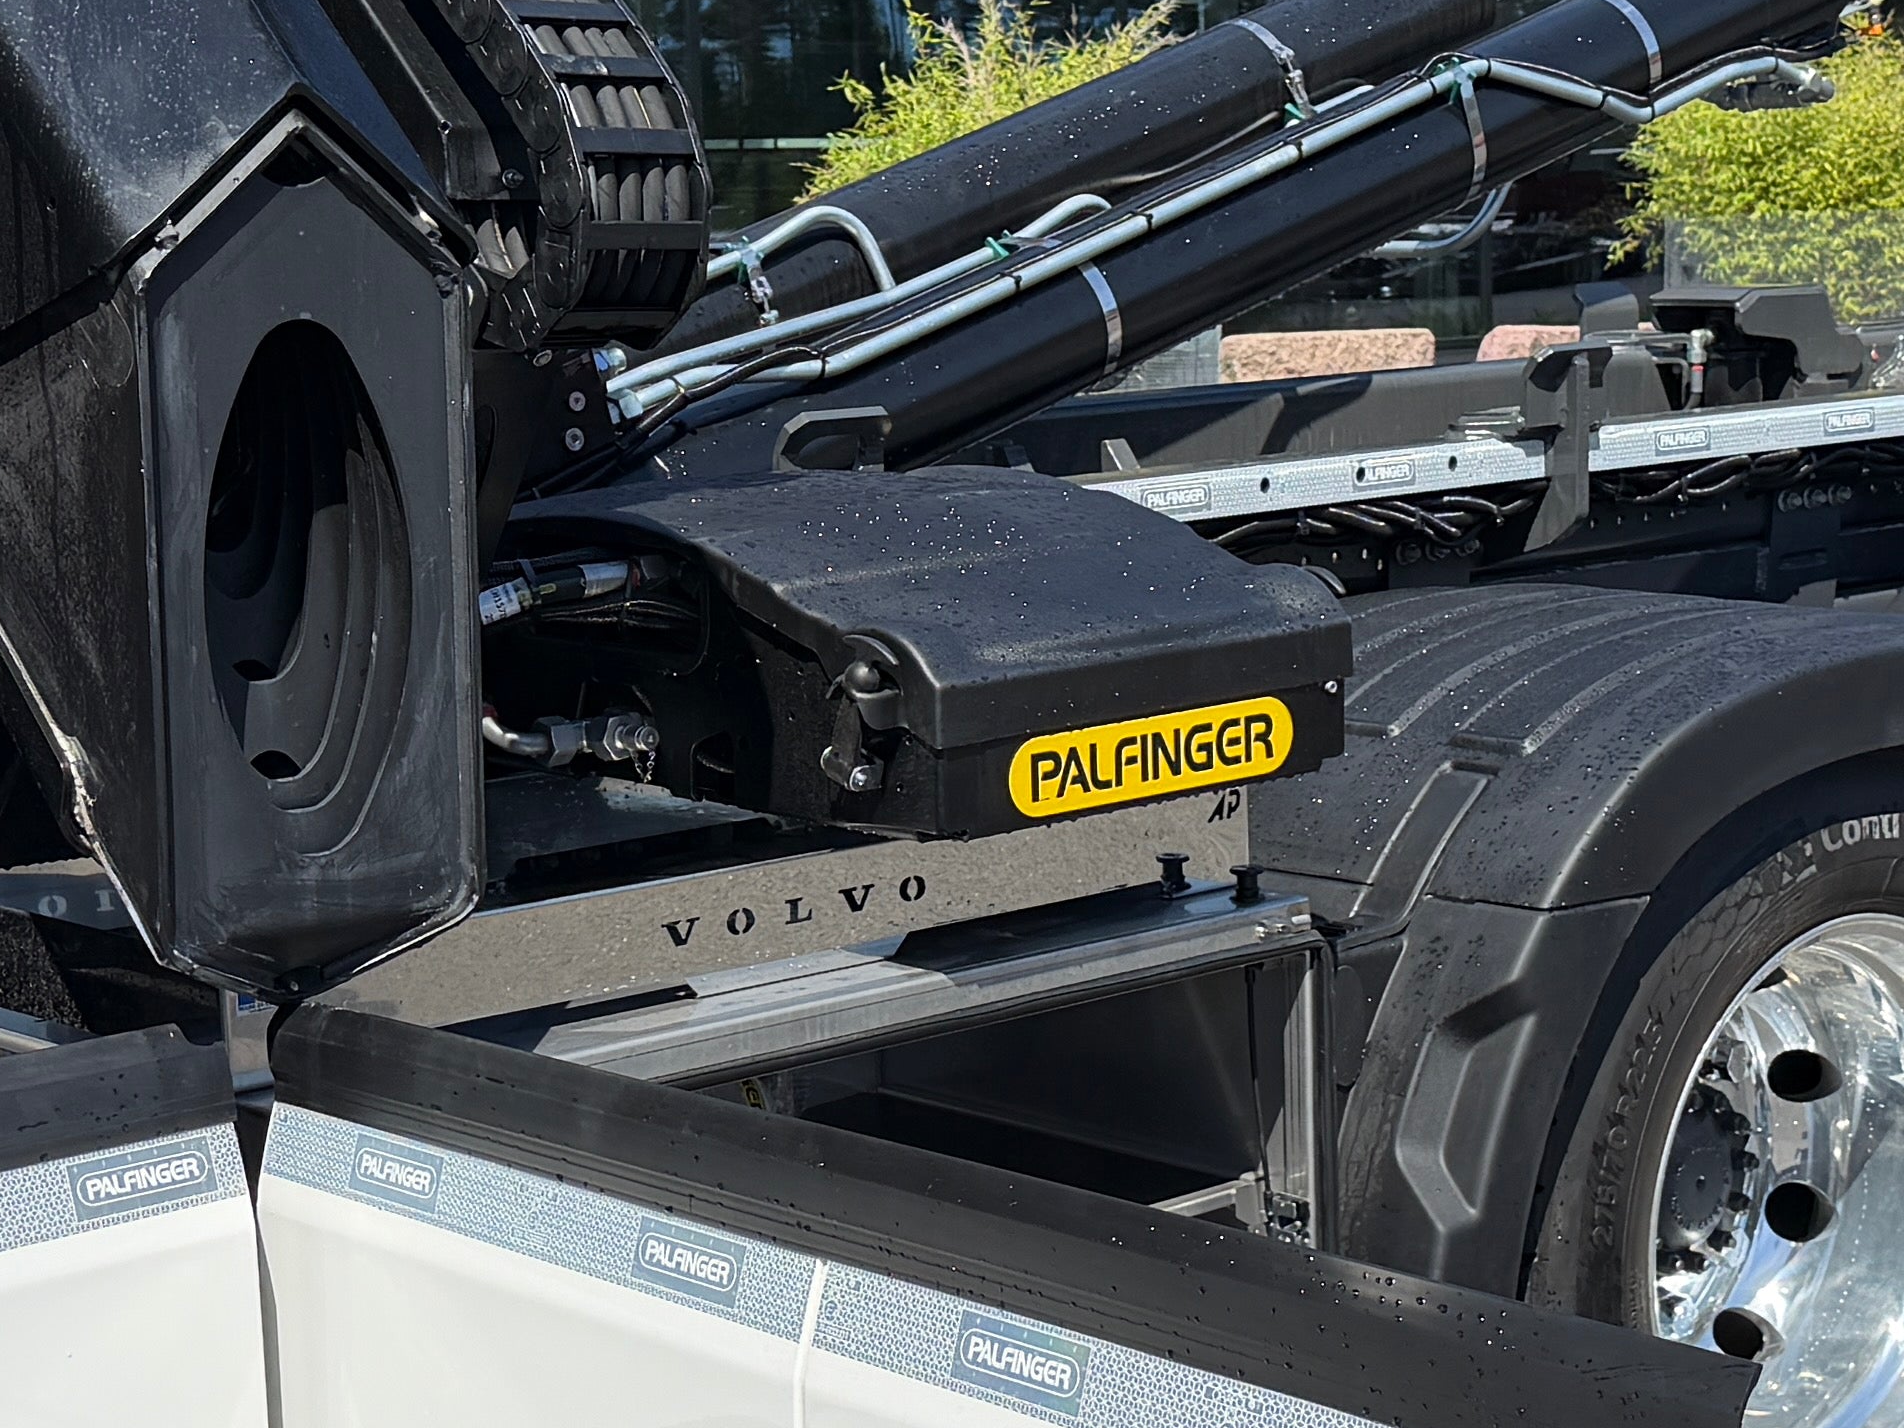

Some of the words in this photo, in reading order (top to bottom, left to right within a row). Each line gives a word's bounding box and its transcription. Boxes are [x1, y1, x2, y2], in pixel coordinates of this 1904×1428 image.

[1659, 430, 1708, 449] PALFINGER
[1358, 461, 1411, 482] ALFINGER
[1146, 489, 1207, 506] PALFINGER
[1030, 713, 1274, 803] PALFINGER
[1207, 788, 1240, 823] AP
[1821, 812, 1900, 852] Conti
[661, 874, 926, 948] VOLVO
[86, 1157, 200, 1200] PALFINGER
[360, 1153, 432, 1193] PALFINGER
[645, 1240, 733, 1285] PALFINGER
[968, 1335, 1072, 1392] PALFINGER
